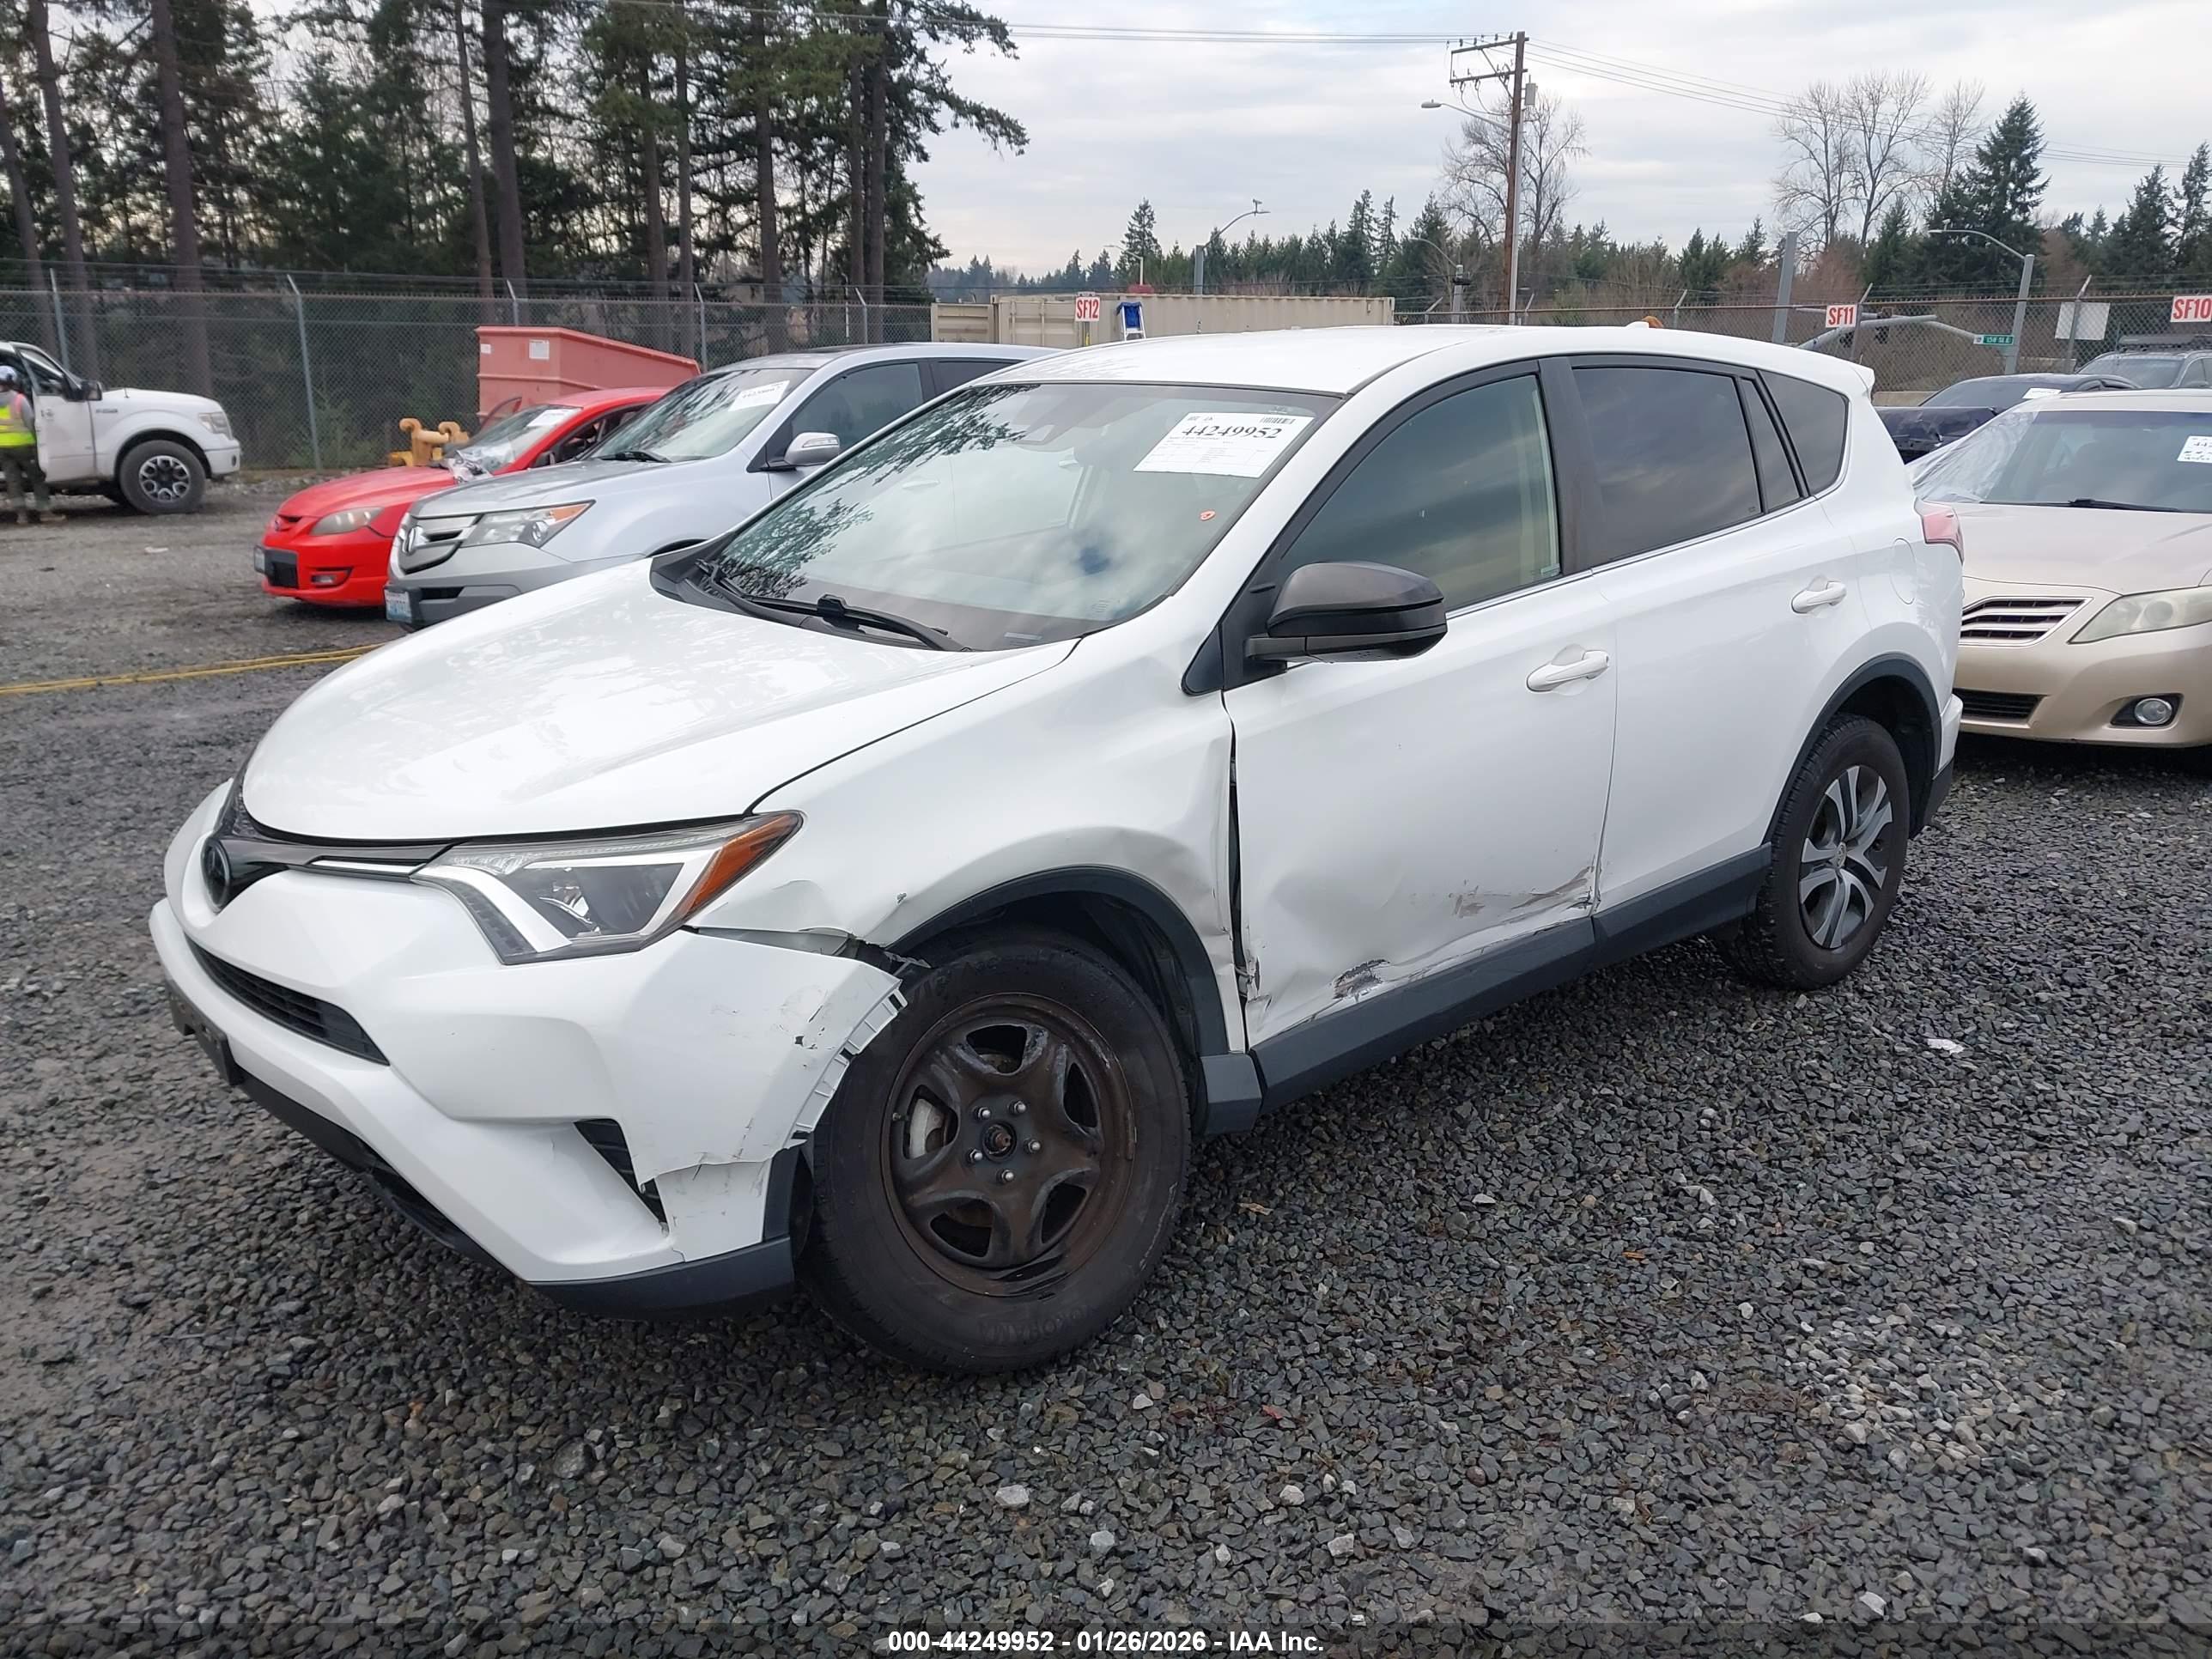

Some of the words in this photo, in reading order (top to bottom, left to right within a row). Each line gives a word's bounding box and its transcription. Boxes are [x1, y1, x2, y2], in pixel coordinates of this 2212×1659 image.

[1077, 299, 1099, 319] SF12
[1828, 307, 1854, 325] SF11
[2173, 298, 2212, 319] SF10
[1181, 425, 1282, 439] 44249952
